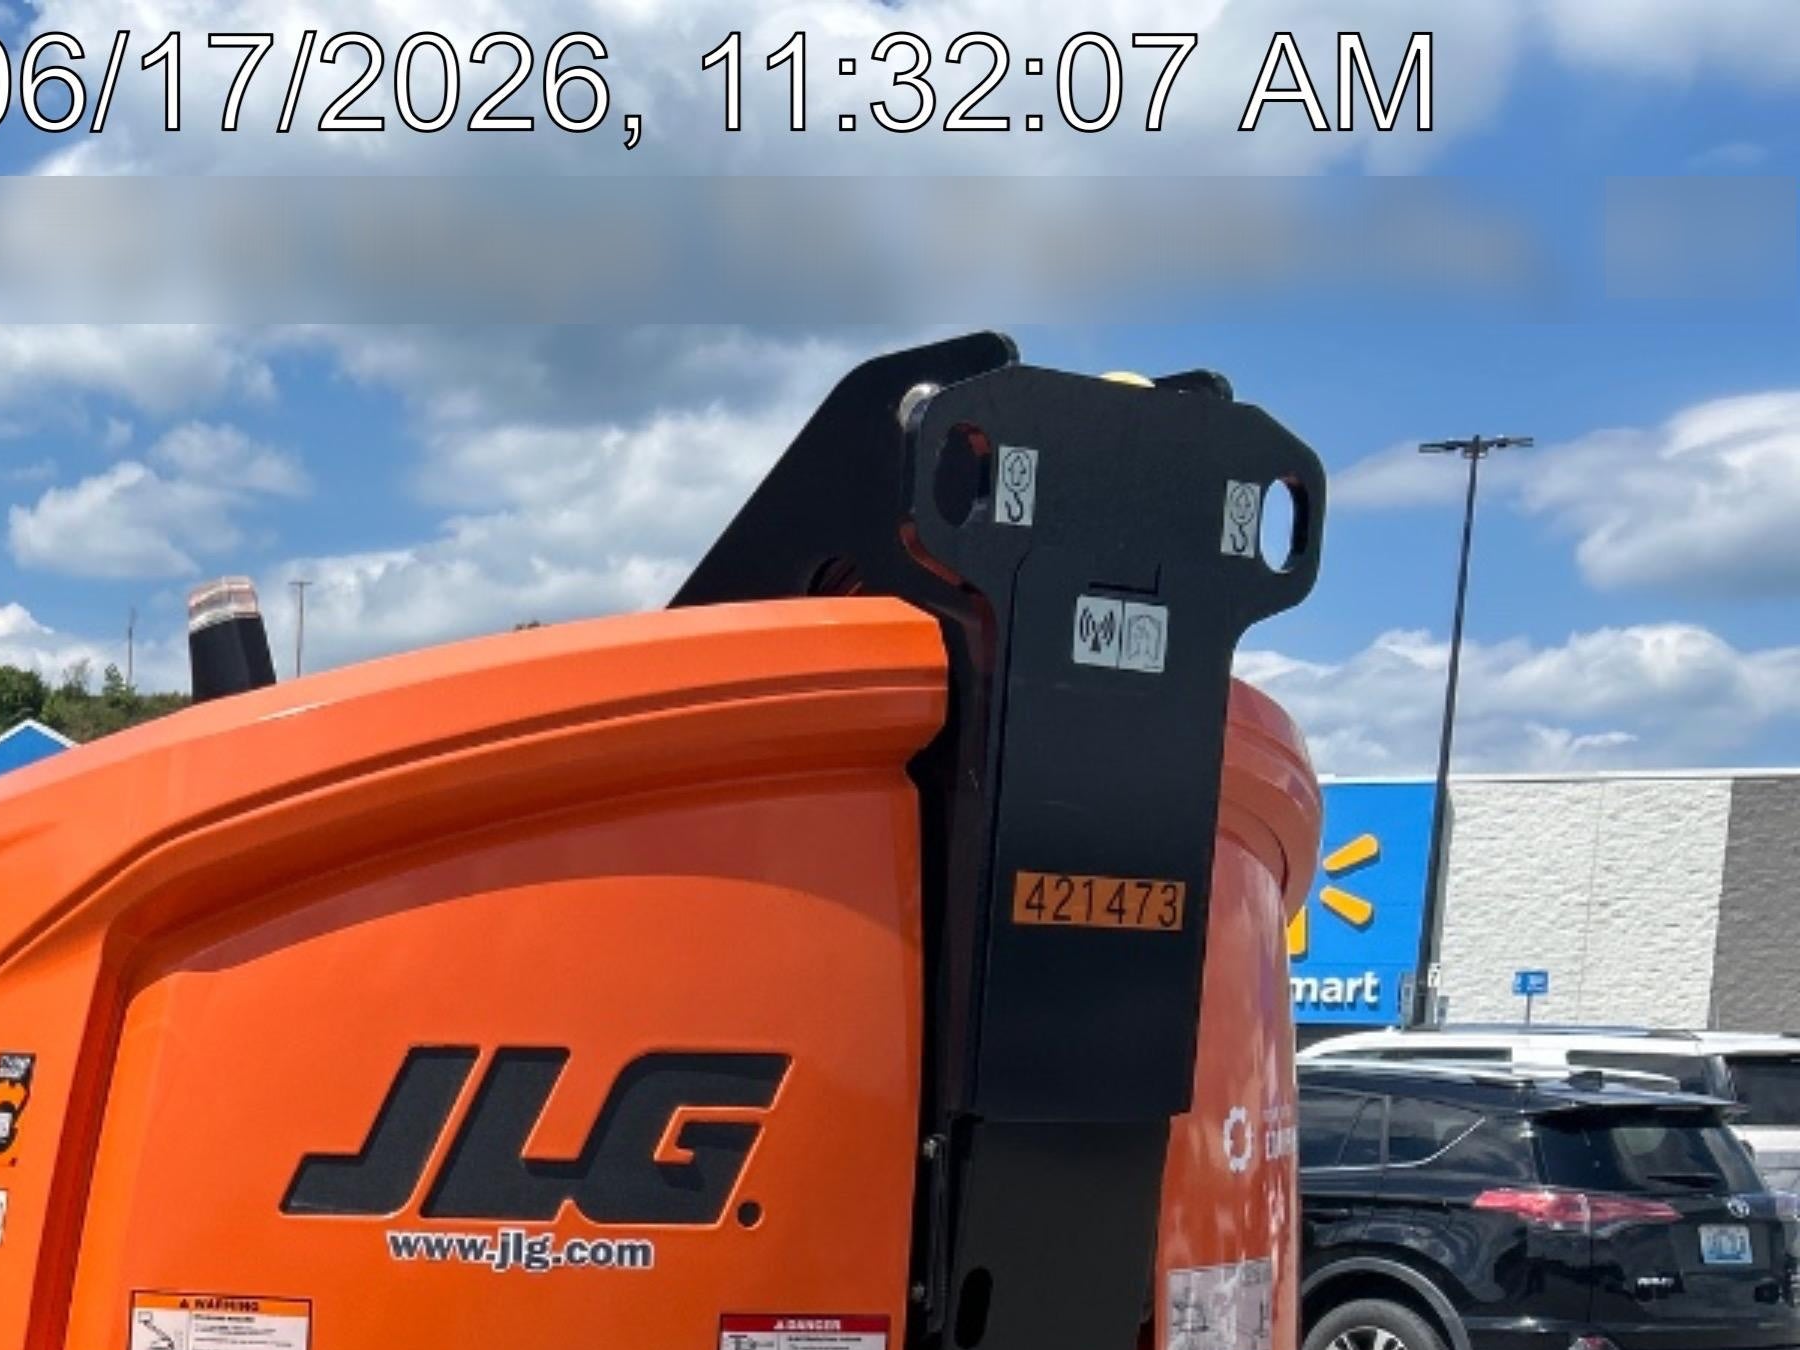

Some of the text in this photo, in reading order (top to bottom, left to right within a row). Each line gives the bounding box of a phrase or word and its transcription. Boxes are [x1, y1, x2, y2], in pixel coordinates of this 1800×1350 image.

[1024, 875, 1178, 928] 421473
[387, 1230, 654, 1270] www.jlg.com
[194, 1298, 260, 1313] WARNING
[787, 1318, 842, 1331] DANGER
